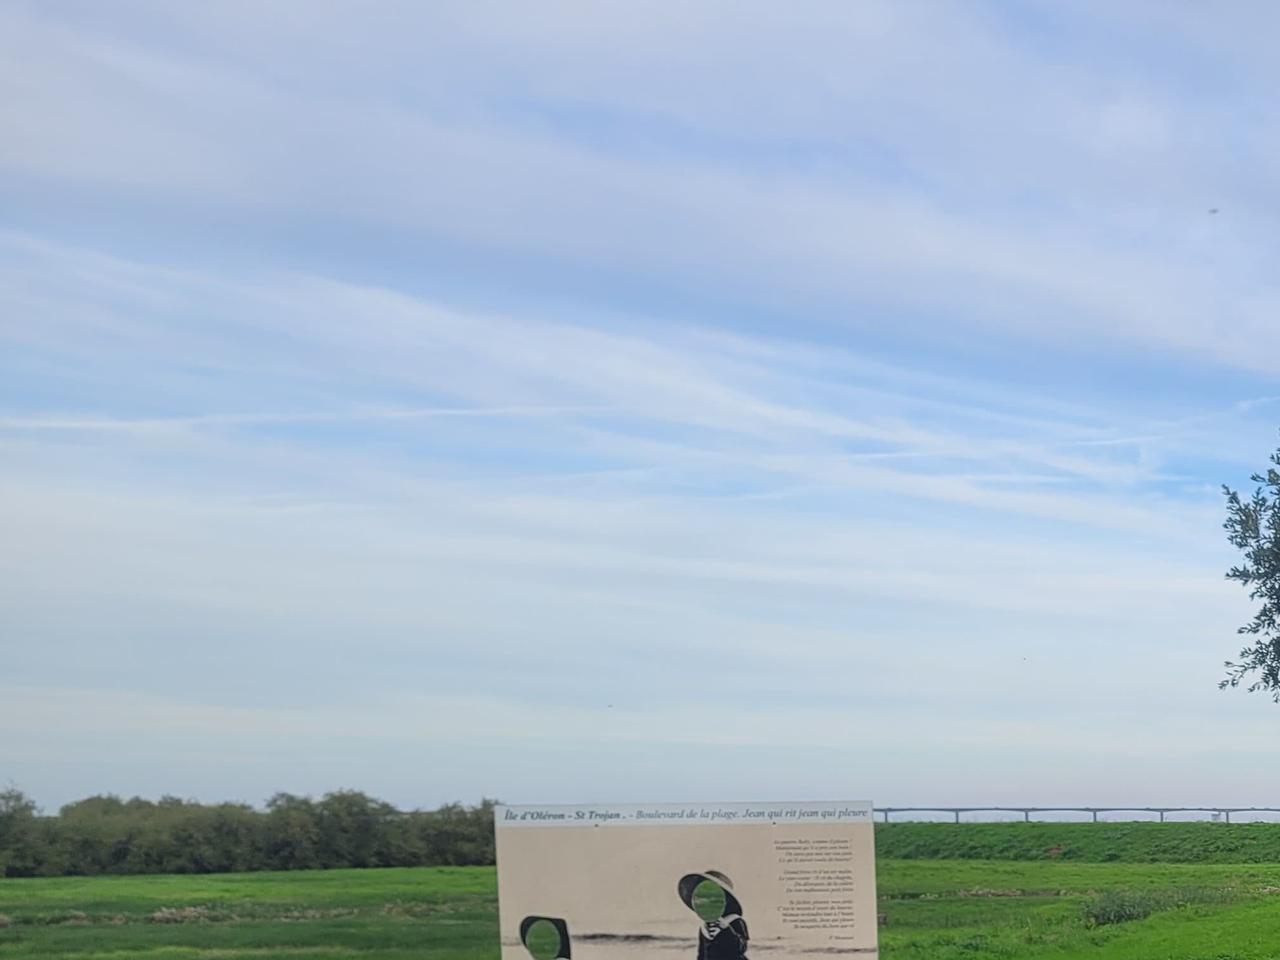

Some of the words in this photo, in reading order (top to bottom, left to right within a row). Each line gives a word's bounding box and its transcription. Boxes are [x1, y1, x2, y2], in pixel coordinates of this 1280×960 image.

[504, 808, 518, 820] Île
[520, 810, 565, 820] d'Oléron
[574, 810, 586, 820] St
[588, 810, 621, 821] Trojan
[635, 809, 685, 819] Boulevard
[686, 809, 698, 818] de
[699, 808, 710, 818] la
[742, 808, 765, 819] Jean
[767, 808, 783, 820] qui
[785, 807, 797, 818] rit
[797, 808, 819, 820] jean
[820, 807, 836, 820] qui
[837, 807, 868, 820] pleure
